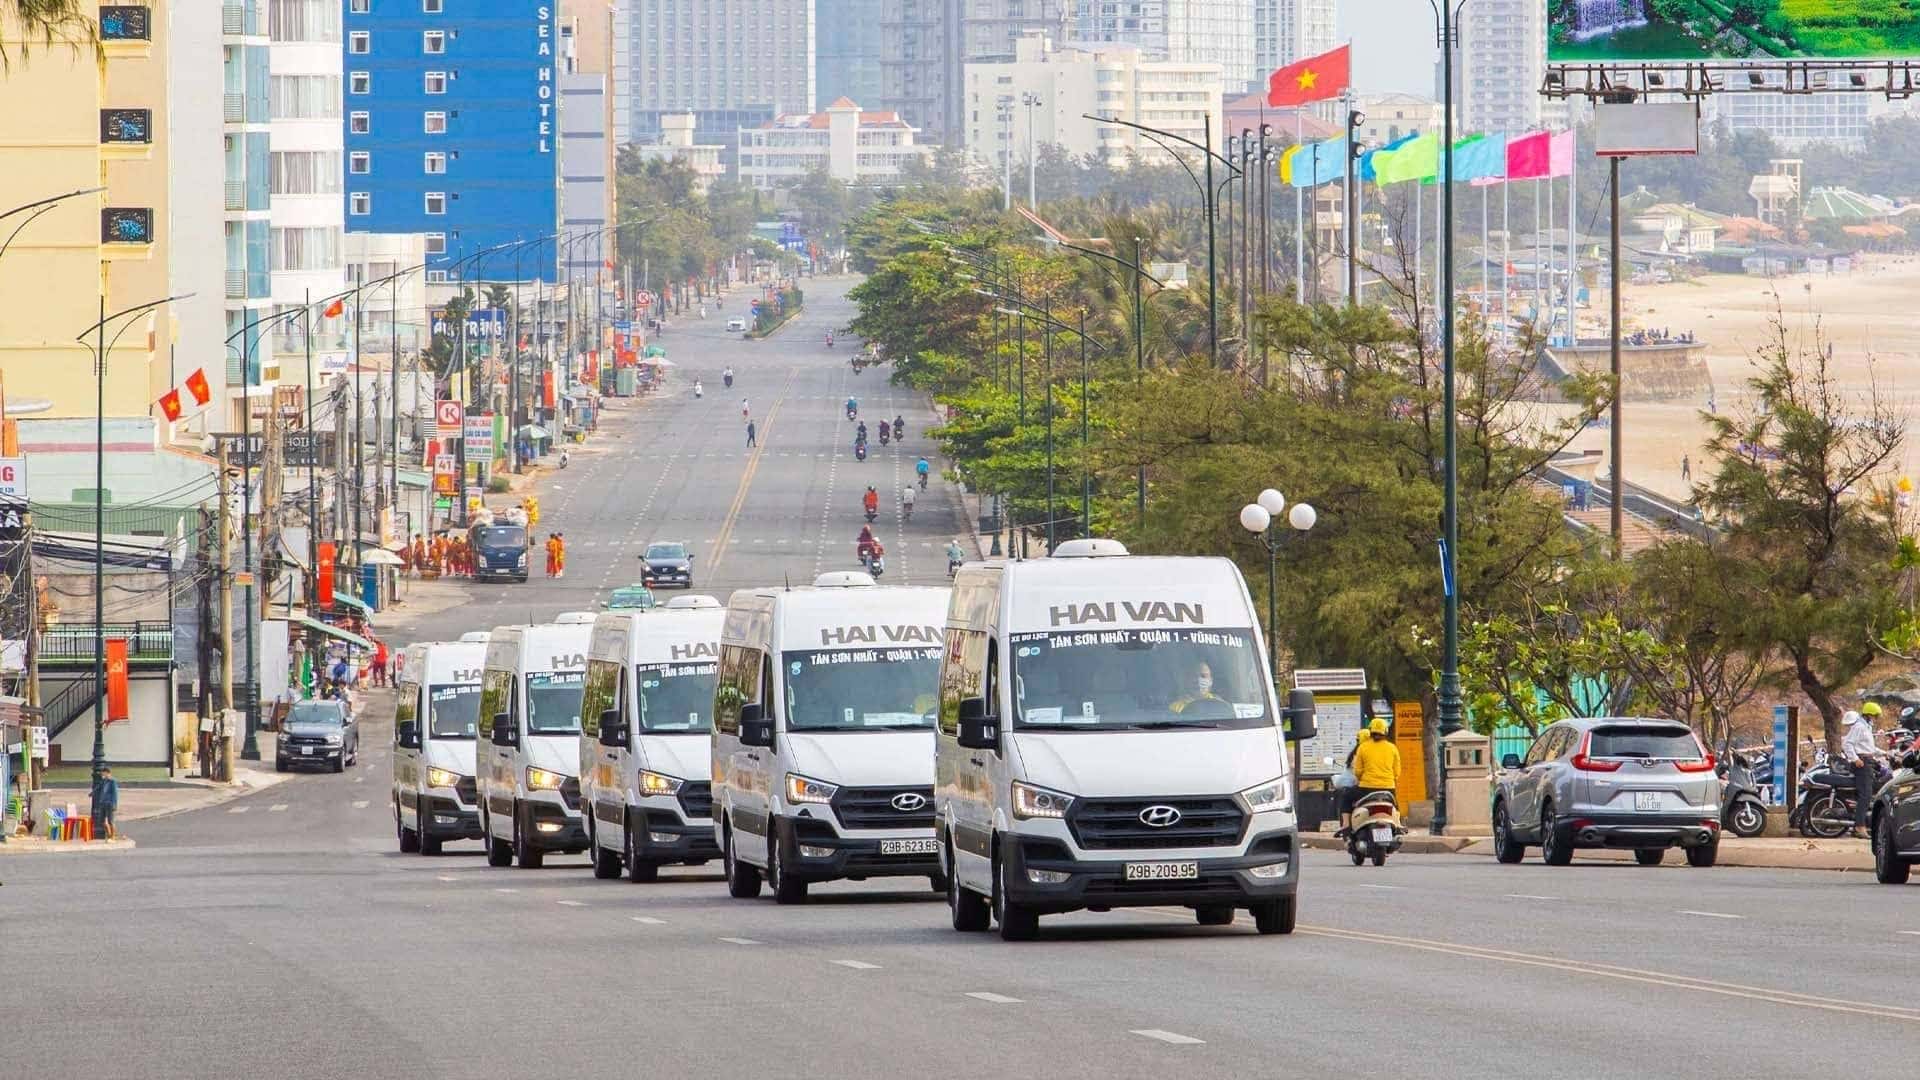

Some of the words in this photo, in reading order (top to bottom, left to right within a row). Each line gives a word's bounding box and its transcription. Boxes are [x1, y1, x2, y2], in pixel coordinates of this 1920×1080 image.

[538, 6, 550, 55] SEA
[538, 67, 551, 153] HOTEL
[1050, 602, 1117, 626] HAI
[1121, 601, 1204, 625] VAN
[821, 625, 877, 646] HAI
[1050, 636, 1072, 649] TÂN
[1074, 633, 1099, 646] SƠN
[1101, 630, 1130, 644] NHẤT
[1140, 631, 1171, 645] QUẬN
[1174, 632, 1180, 642] 1
[1191, 631, 1220, 646] VŨNG
[1222, 633, 1243, 648] TÀU
[671, 642, 719, 660] HAI
[810, 654, 830, 665] TÂN
[831, 652, 851, 664] SƠN
[853, 649, 878, 662] NHẤT
[886, 650, 913, 663] QUẬN
[926, 648, 943, 660] VŨN
[552, 654, 586, 669] HA
[453, 669, 483, 682] HA
[1128, 863, 1196, 879] 29B-209.95
